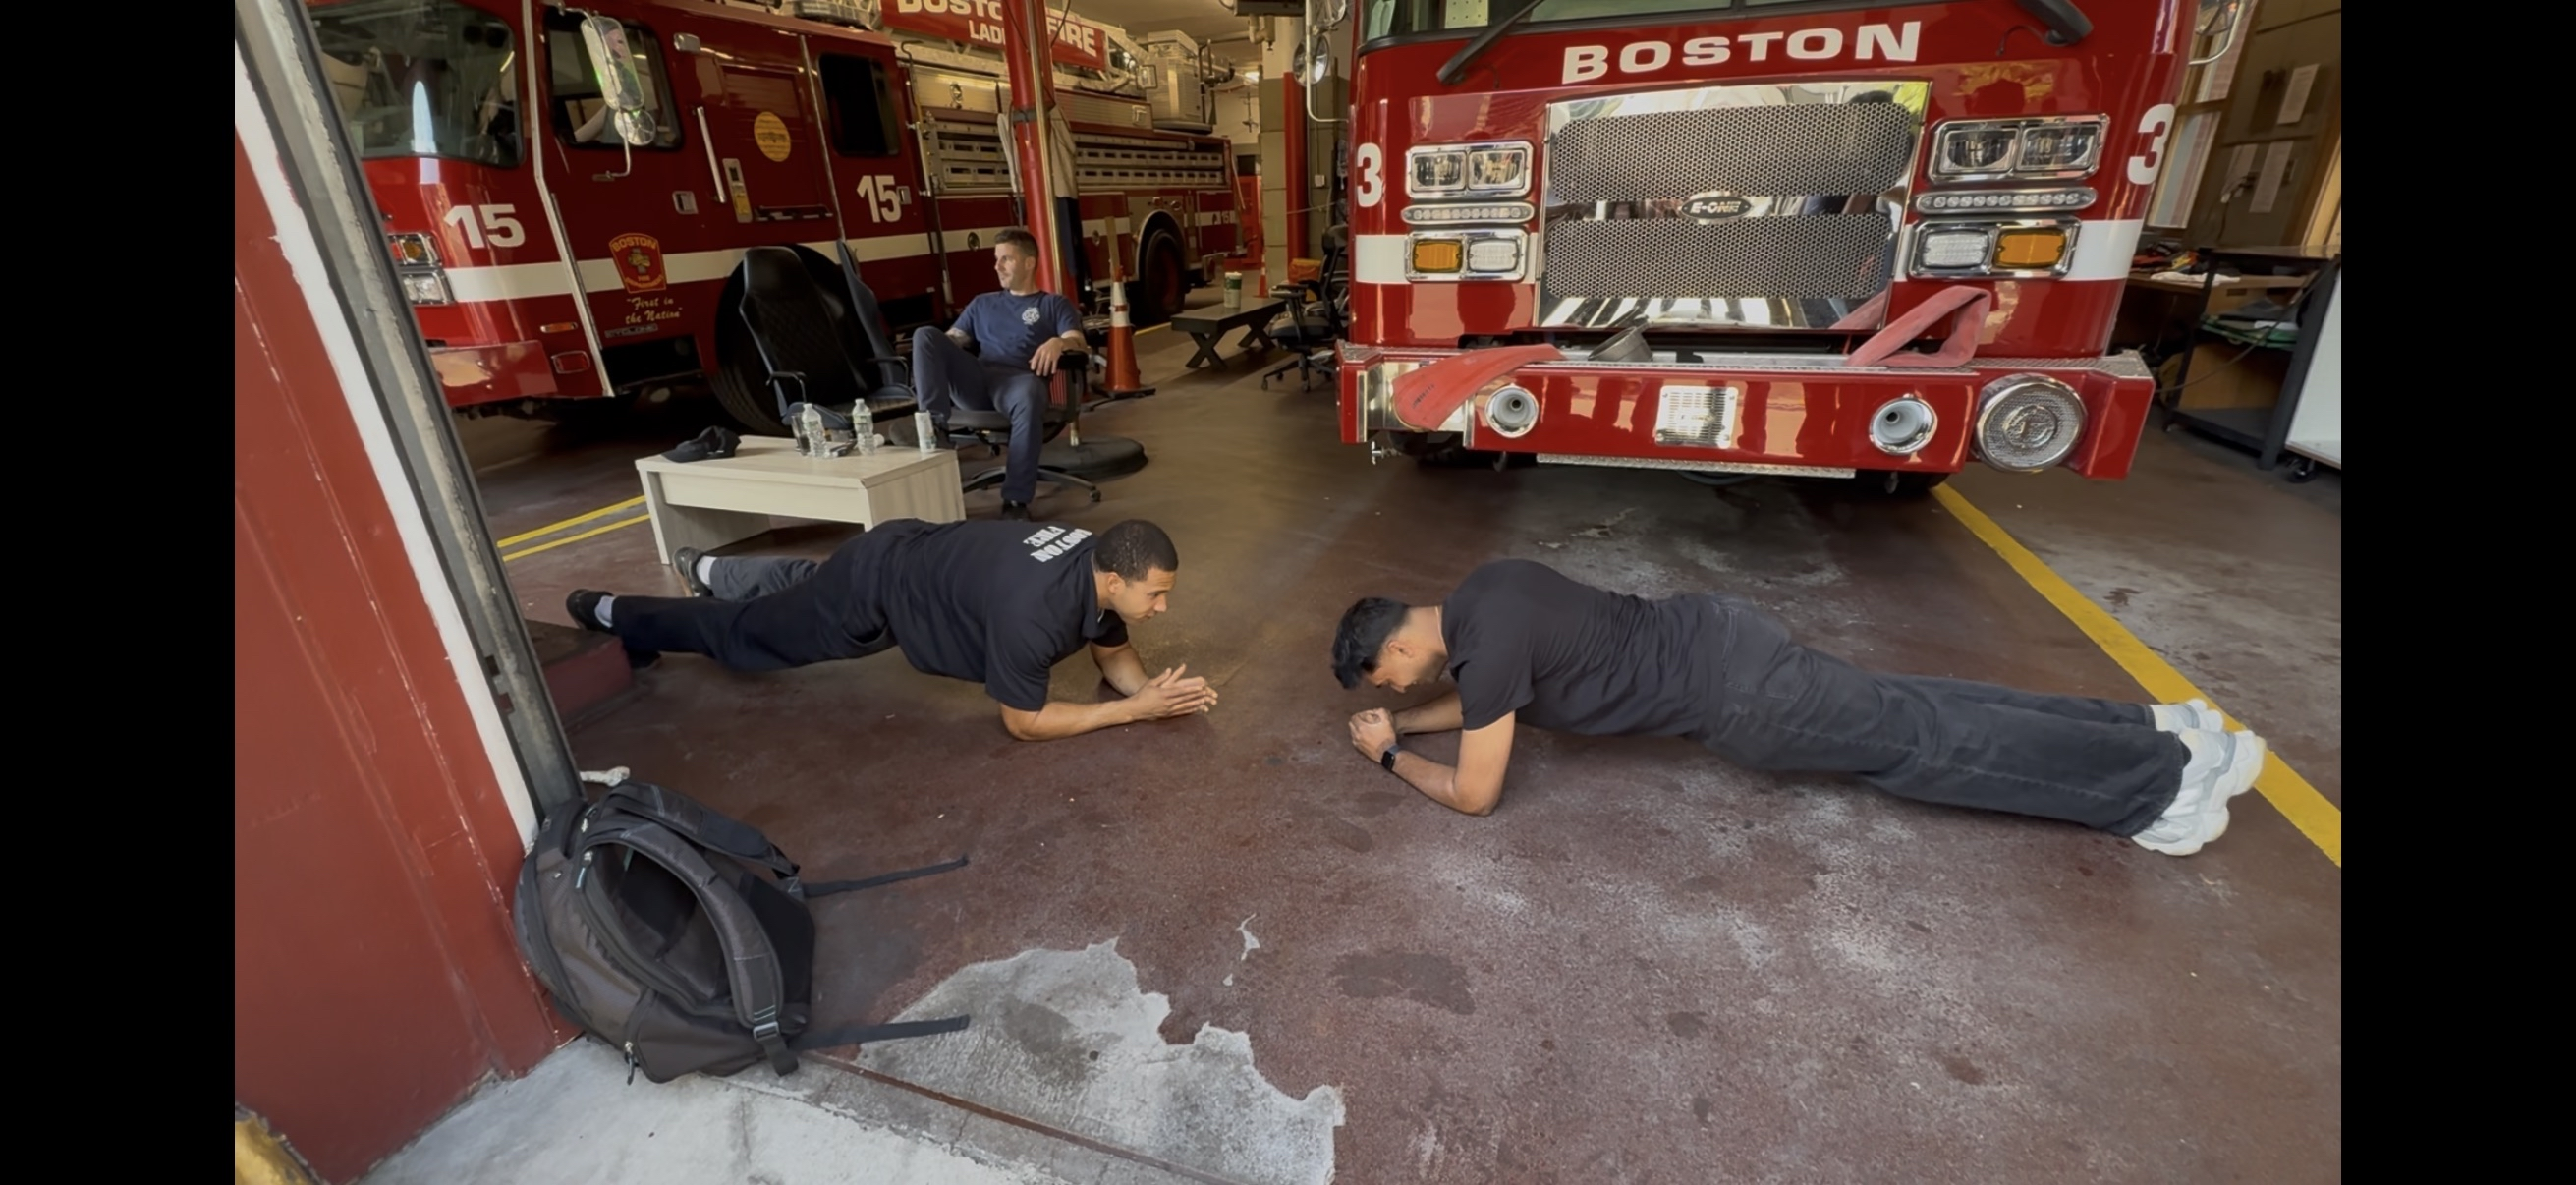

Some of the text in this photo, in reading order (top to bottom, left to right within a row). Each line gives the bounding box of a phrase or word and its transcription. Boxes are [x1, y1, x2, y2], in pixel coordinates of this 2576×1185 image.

[897, 0, 1097, 57] BOSTO FIRE
[968, 19, 1005, 45] LAD
[1561, 21, 1921, 85] BOSTON
[2127, 103, 2175, 185] 3
[1357, 142, 1382, 207] 3
[856, 174, 902, 223] 15
[1690, 200, 1742, 214] E-ONE
[443, 204, 526, 249] 15
[611, 237, 657, 252] BOSTON
[625, 312, 642, 324] the
